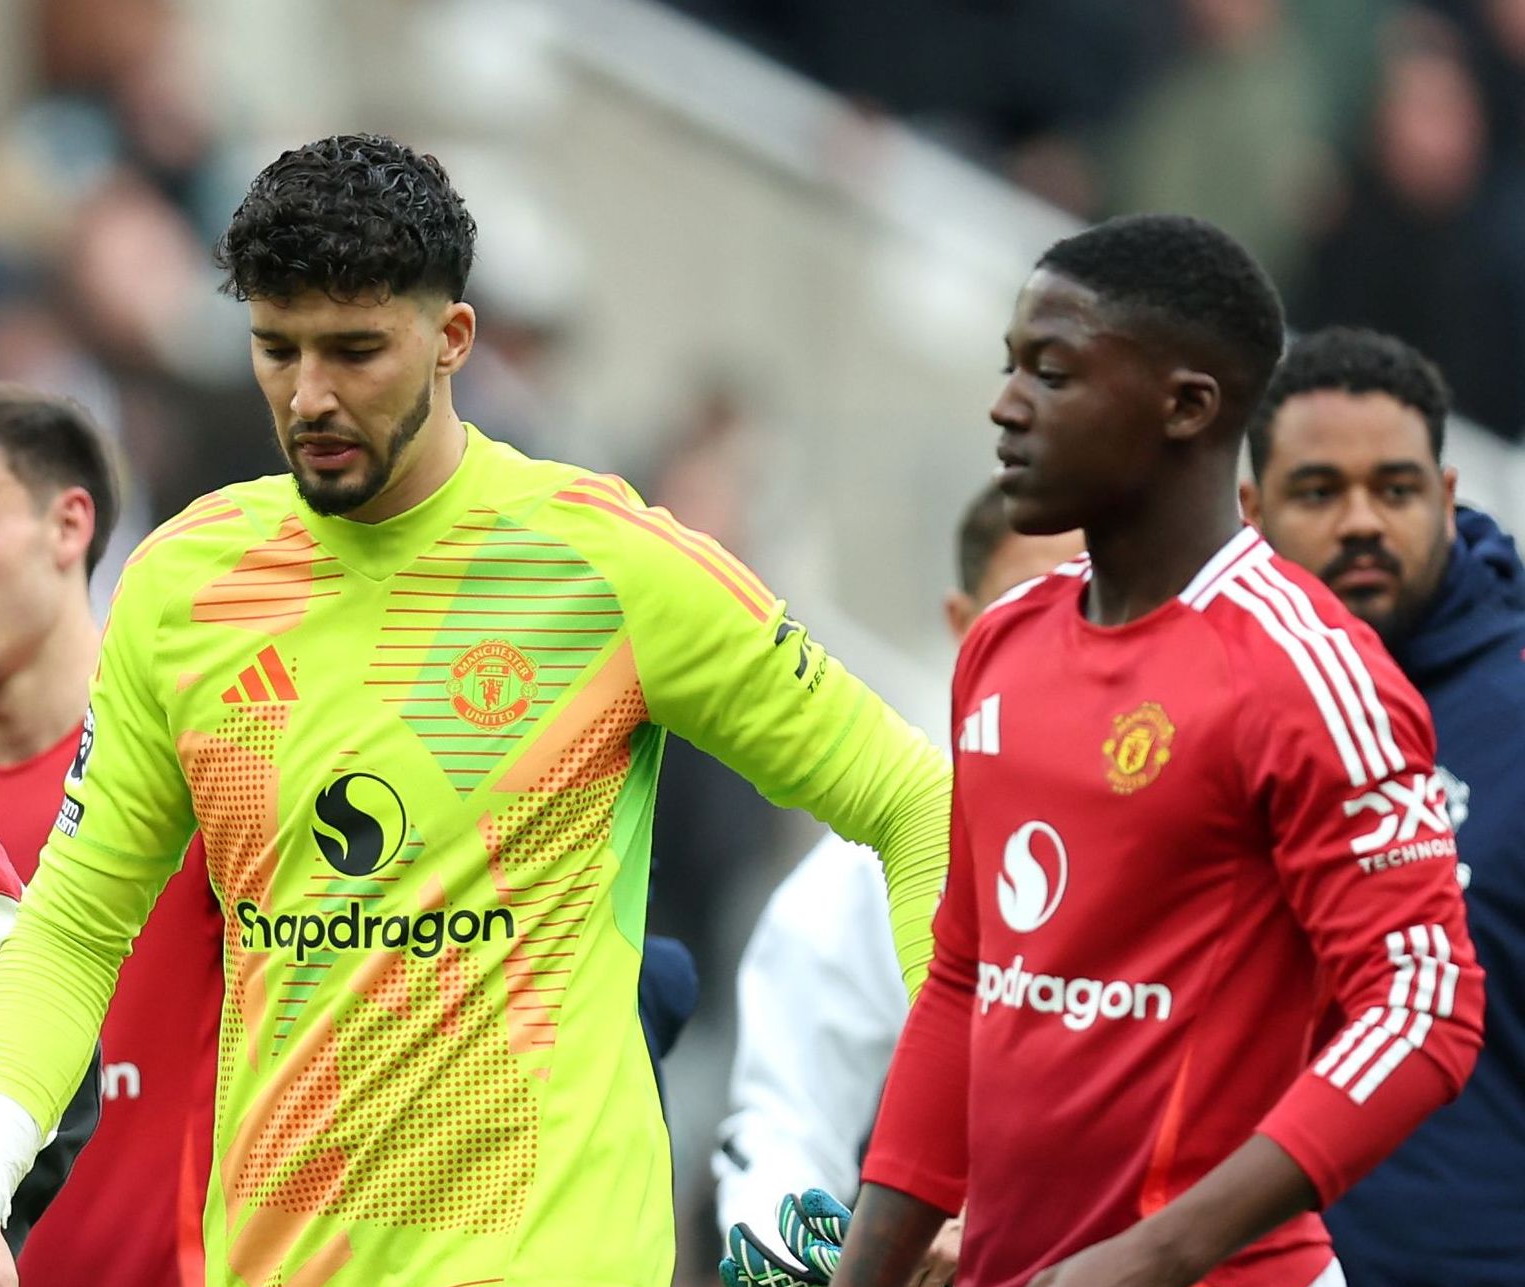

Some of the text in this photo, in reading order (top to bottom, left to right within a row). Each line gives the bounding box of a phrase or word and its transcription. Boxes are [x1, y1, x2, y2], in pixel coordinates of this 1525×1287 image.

[457, 645, 530, 677] MANCHESTER
[464, 708, 516, 724] UNITED
[1357, 838, 1457, 874] TECHNOL
[236, 900, 516, 962] Snapdragon
[977, 954, 1173, 1031] pdragon
